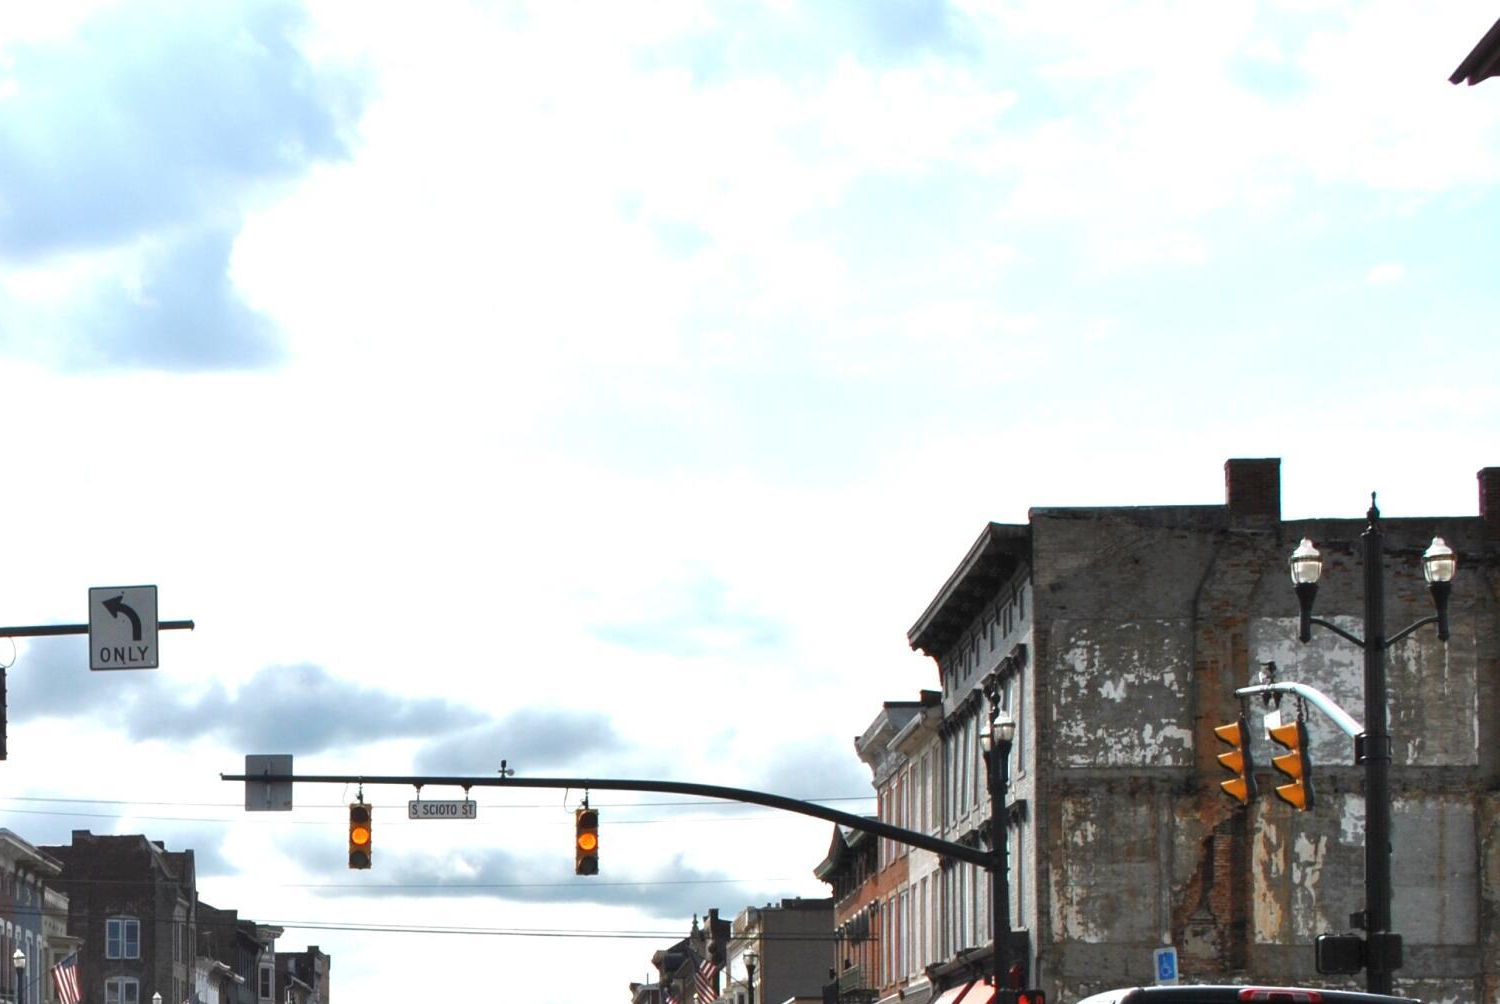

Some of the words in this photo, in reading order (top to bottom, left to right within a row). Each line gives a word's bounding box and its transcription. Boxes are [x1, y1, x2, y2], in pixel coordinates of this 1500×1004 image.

[100, 646, 148, 663] ONLY
[412, 804, 418, 815] S
[422, 804, 457, 815] SCIOTO
[462, 804, 474, 815] ST
